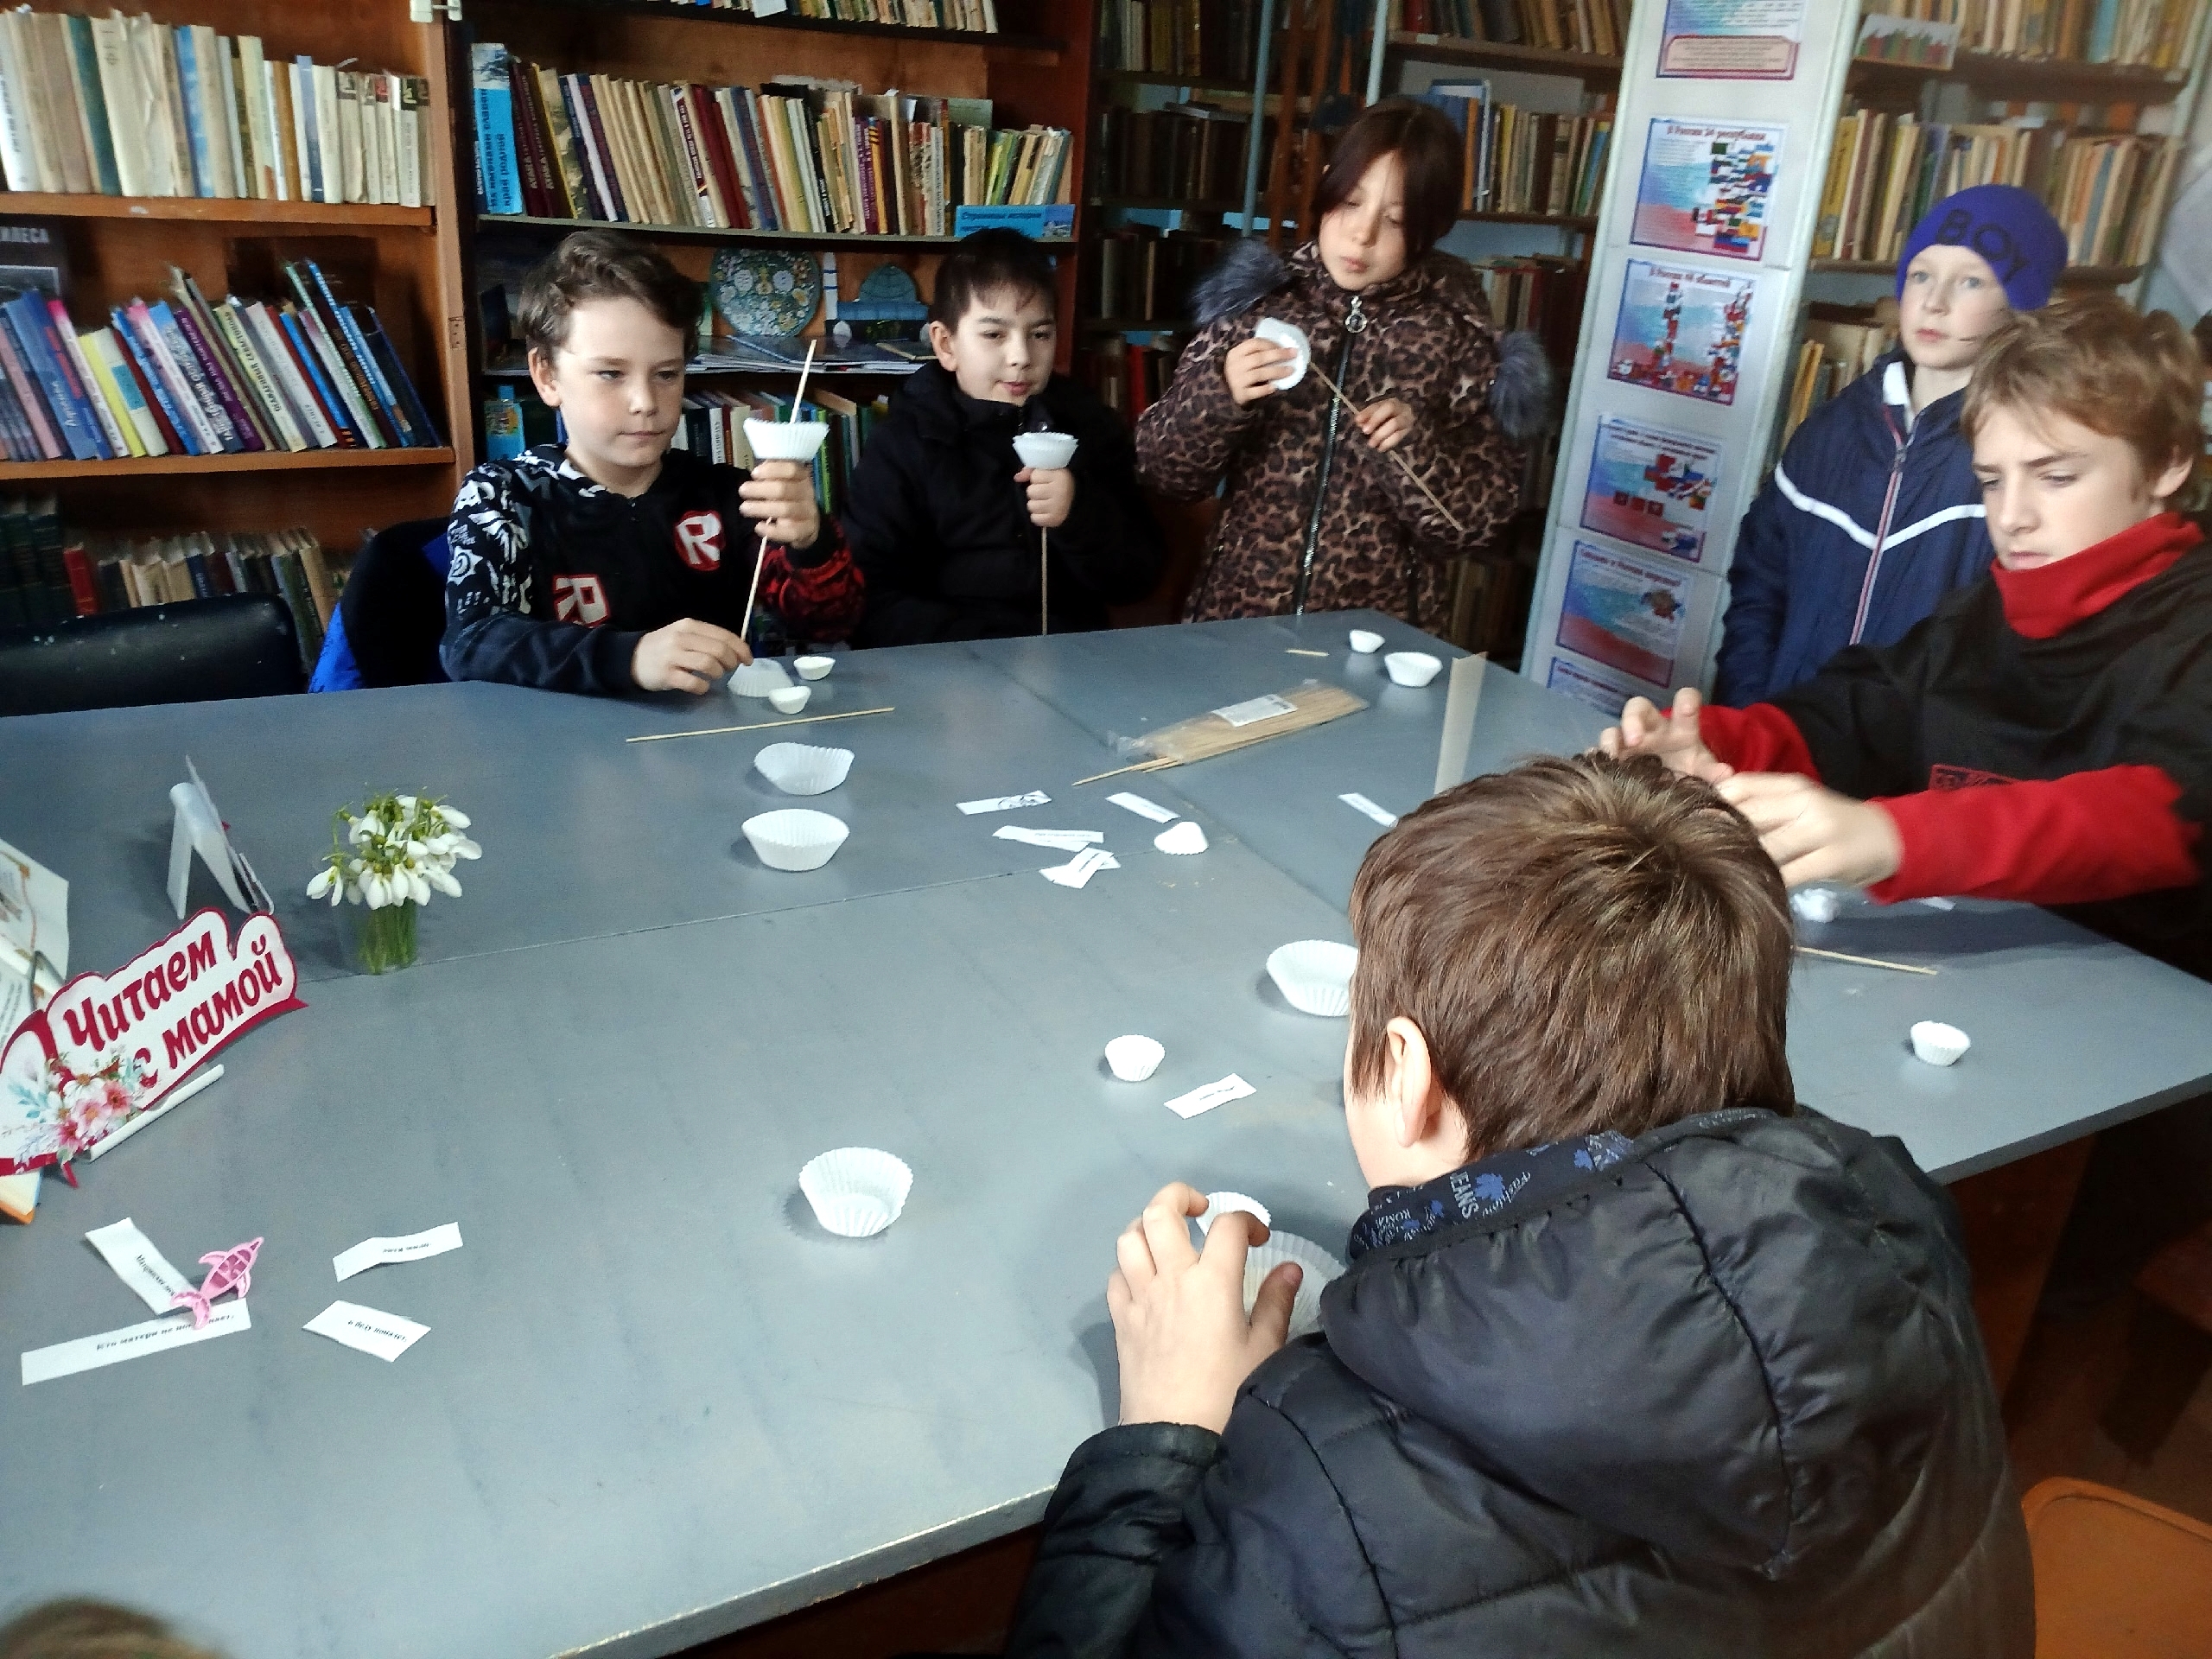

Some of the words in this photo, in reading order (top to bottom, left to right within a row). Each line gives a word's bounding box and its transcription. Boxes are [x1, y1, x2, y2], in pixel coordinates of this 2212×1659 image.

[1936, 208, 2030, 285] BOY
[63, 931, 217, 1052] Читаем
[132, 1047, 159, 1089] с
[162, 934, 283, 1070] мамой
